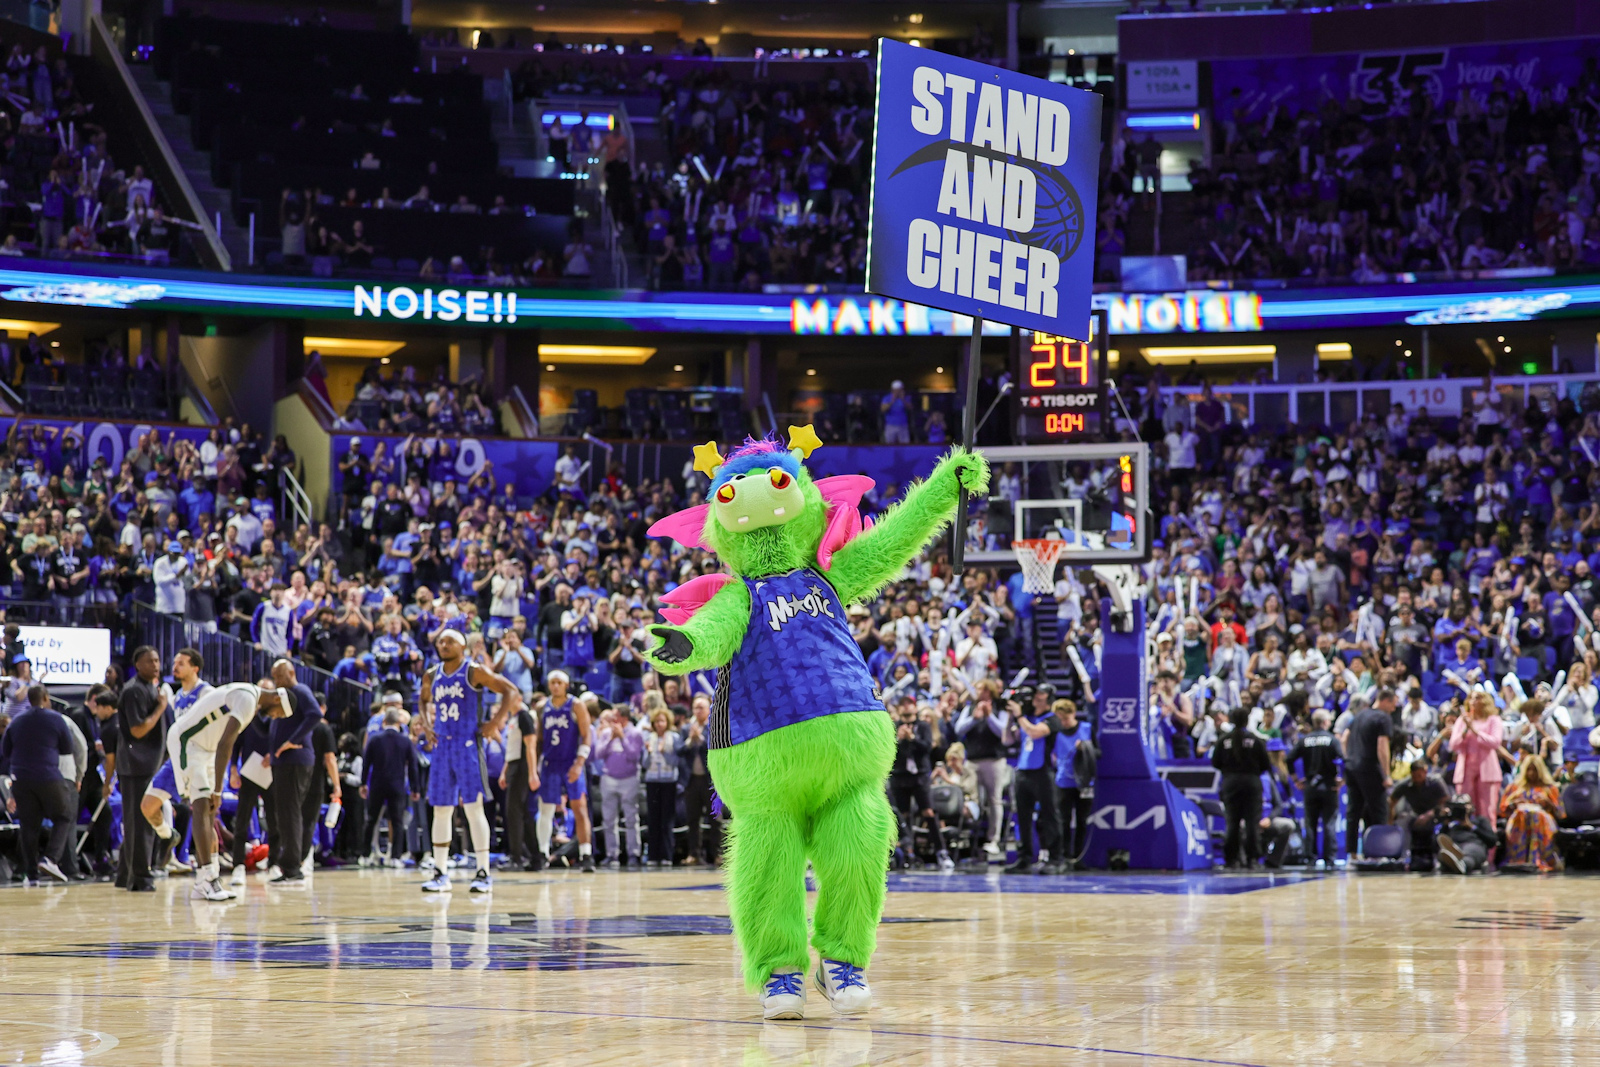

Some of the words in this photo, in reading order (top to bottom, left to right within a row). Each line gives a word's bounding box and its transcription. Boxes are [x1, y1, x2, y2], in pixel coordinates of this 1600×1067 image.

[911, 66, 1071, 167] STAND
[936, 148, 1037, 234] AND
[906, 218, 1060, 319] CHEER
[353, 284, 517, 324] NOISE!!
[1030, 343, 1088, 387] 24
[1041, 394, 1098, 407] TISSOT
[1407, 386, 1446, 405] 110
[1045, 413, 1084, 434] 0:04
[49, 638, 62, 650] by
[36, 657, 91, 673] Health
[439, 702, 460, 722] 34
[550, 729, 560, 746] 5
